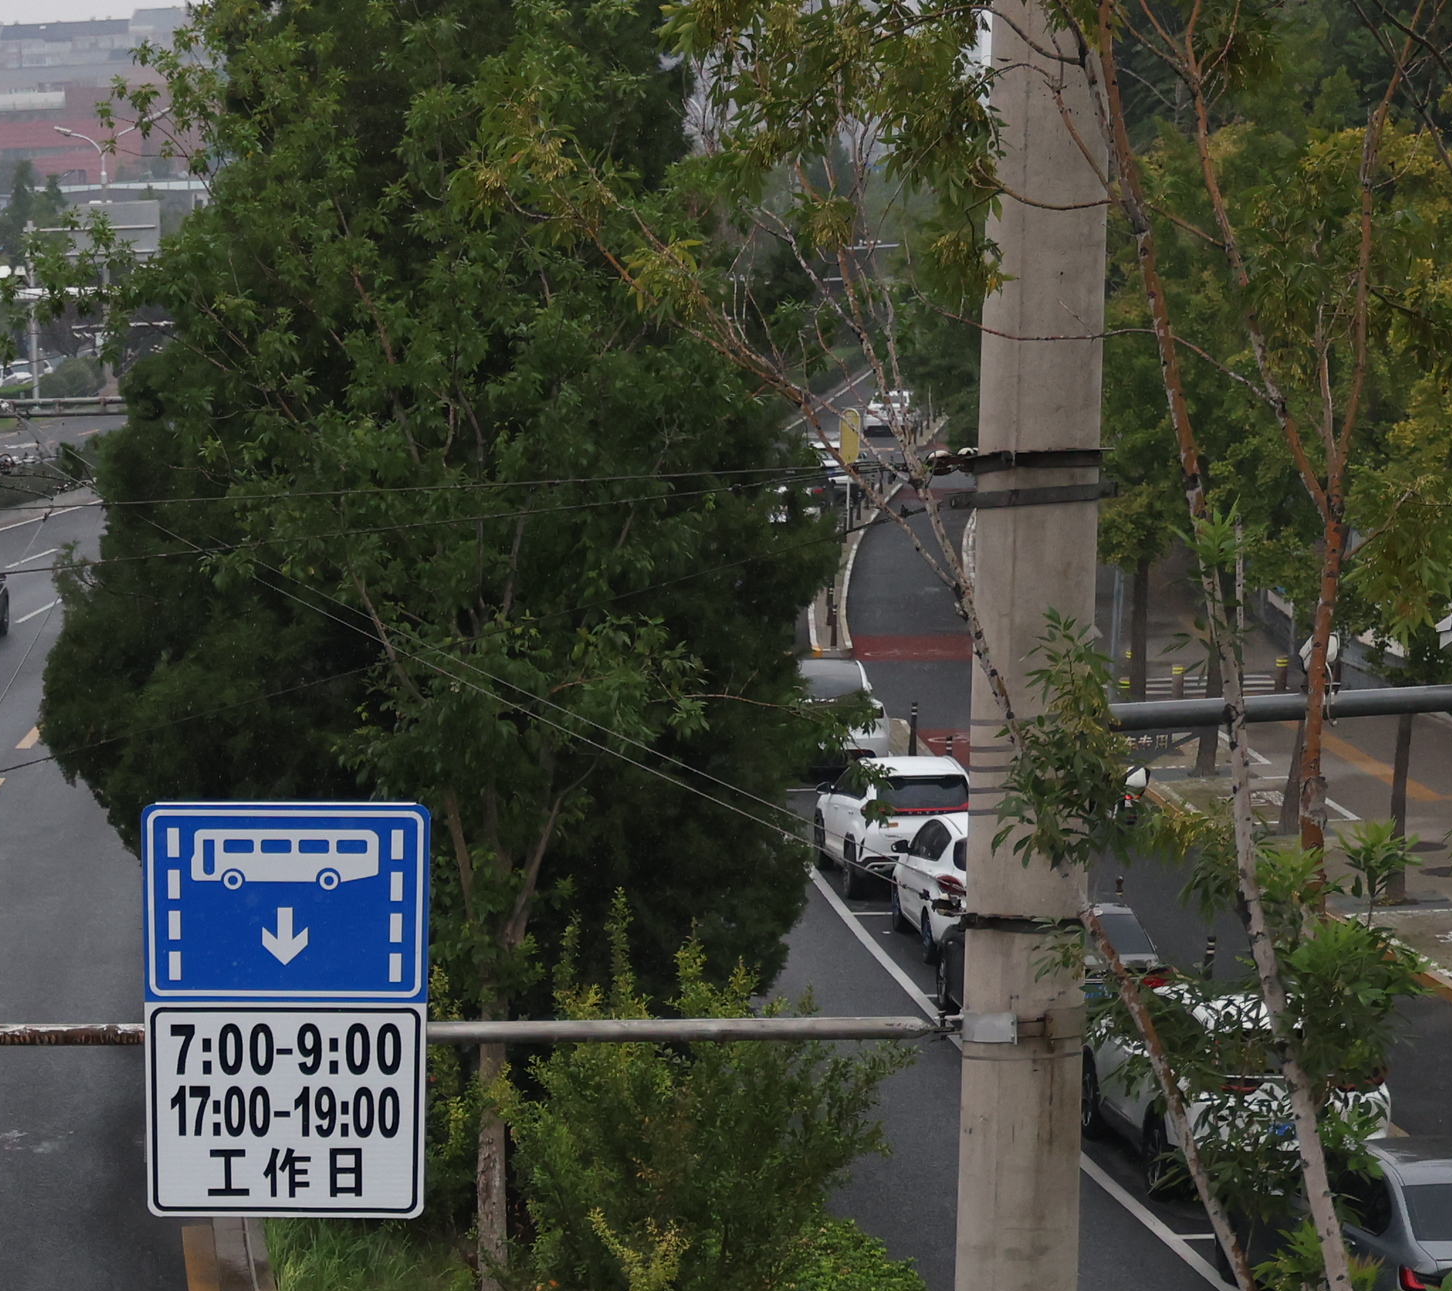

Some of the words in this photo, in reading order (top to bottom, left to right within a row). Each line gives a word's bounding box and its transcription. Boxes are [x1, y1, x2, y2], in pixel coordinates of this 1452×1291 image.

[170, 1022, 403, 1076] 7:00-9:00
[170, 1085, 401, 1138] 17:00-19:00
[207, 1147, 364, 1198] 工作日
